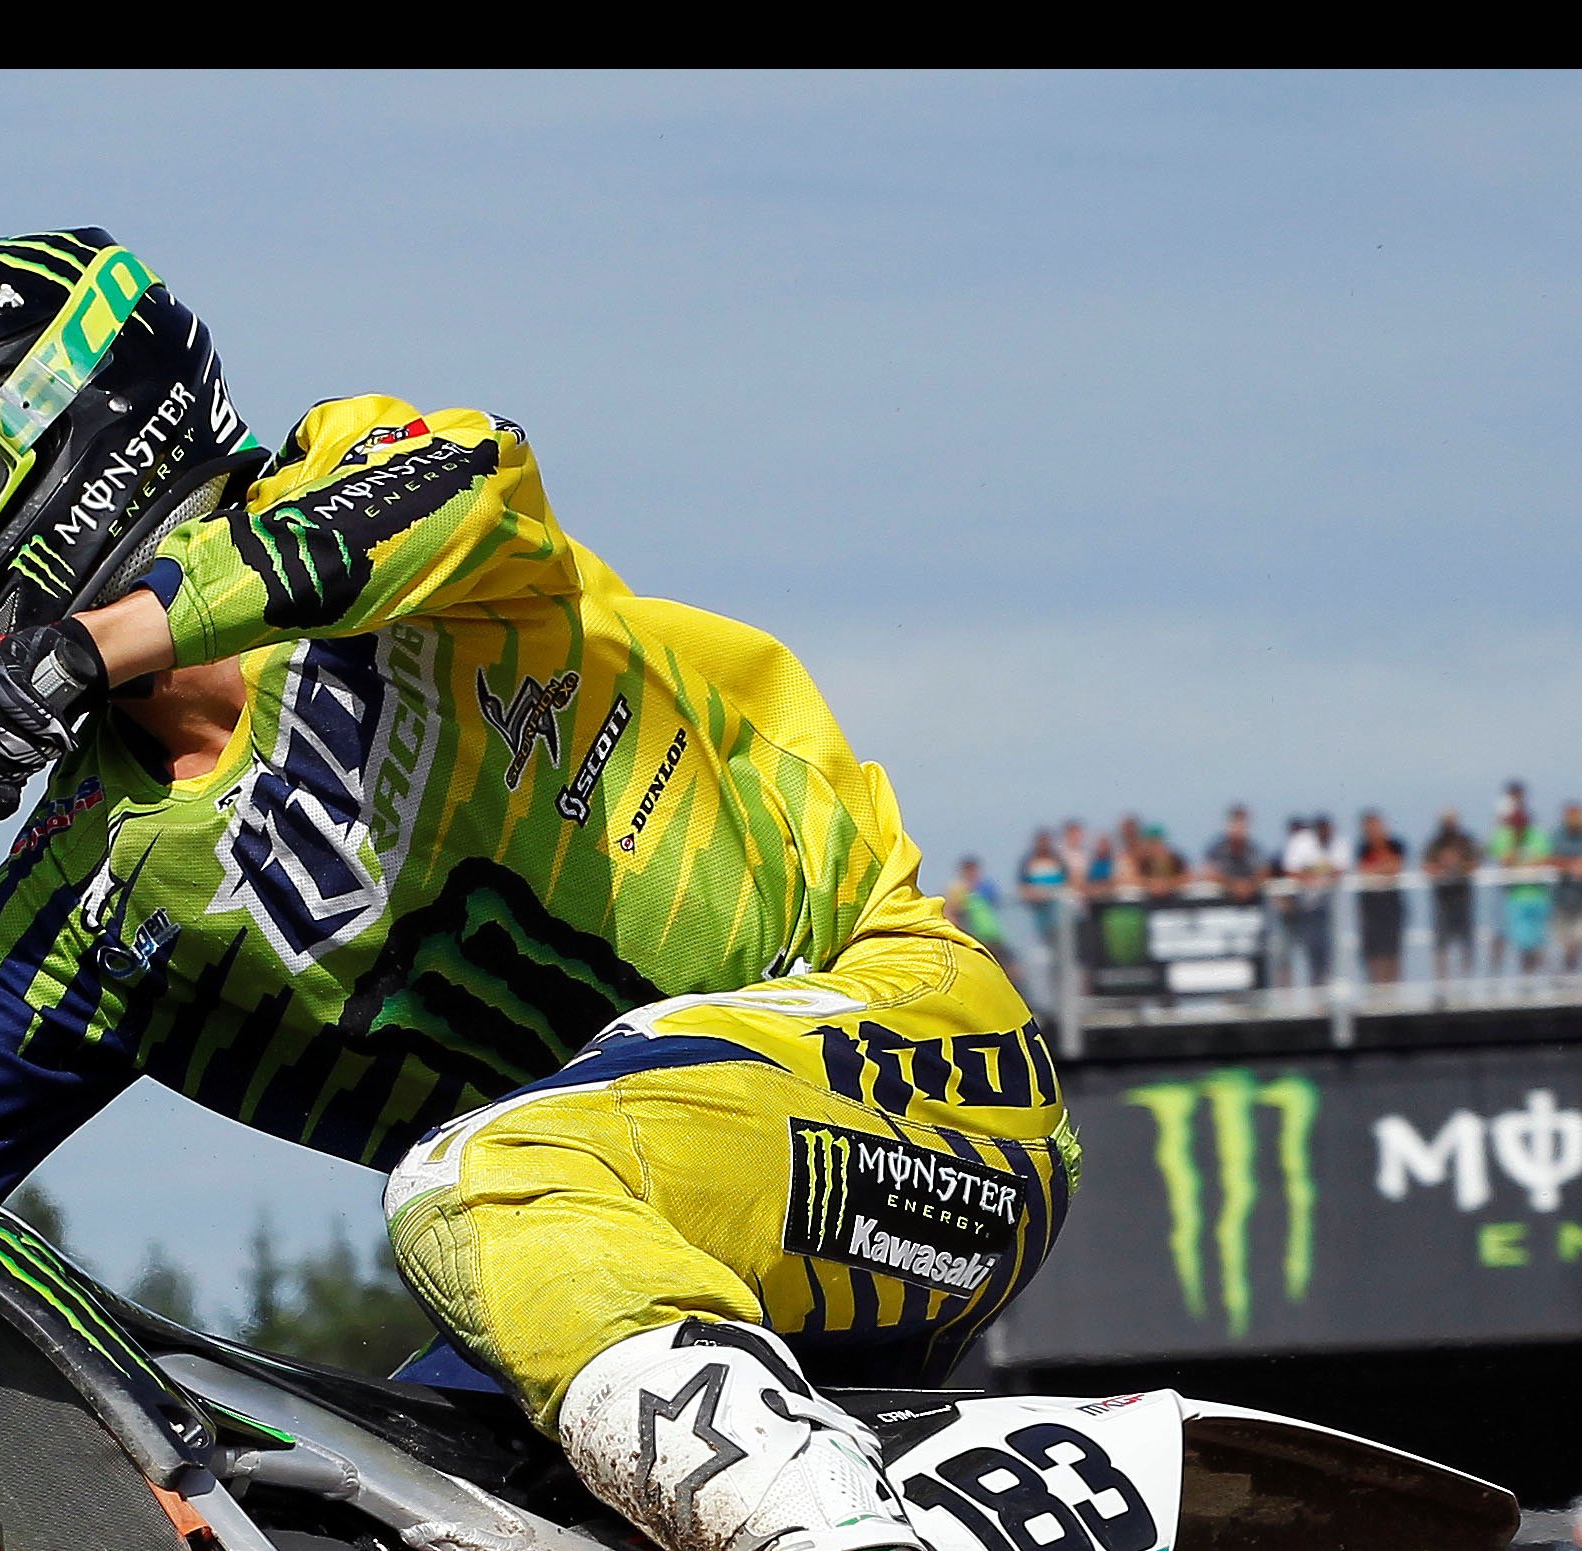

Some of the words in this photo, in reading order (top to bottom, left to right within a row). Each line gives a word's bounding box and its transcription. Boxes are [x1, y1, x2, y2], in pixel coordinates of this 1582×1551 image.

[108, 427, 194, 537] ENERGY
[577, 700, 627, 798] SCOTT
[632, 728, 687, 833] DUNLOP
[858, 1142, 1018, 1225] MONSTER
[888, 1194, 985, 1236] ENERGY
[849, 1215, 996, 1291] Kawasaki
